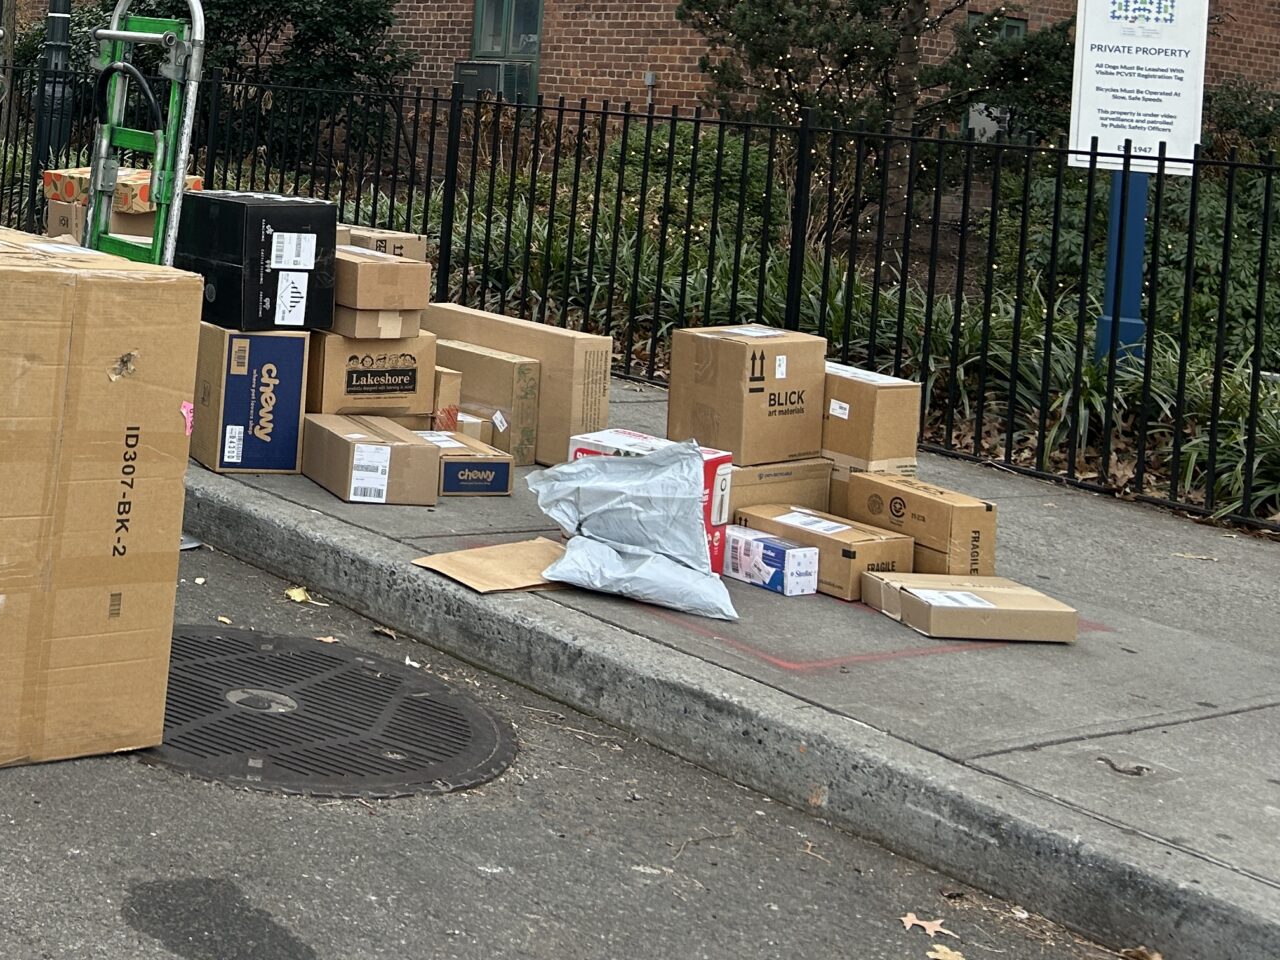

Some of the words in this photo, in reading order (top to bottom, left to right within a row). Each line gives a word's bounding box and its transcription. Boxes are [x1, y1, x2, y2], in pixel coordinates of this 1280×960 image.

[1090, 43, 1133, 54] PRIVATE
[1135, 47, 1190, 58] PROPERTY
[352, 373, 410, 385] Lakeshore
[254, 363, 280, 443] chewy
[768, 390, 805, 407] BLICK
[768, 409, 777, 417] art
[778, 407, 805, 416] materials
[458, 468, 495, 482] chewy
[112, 426, 140, 557] ID307-BK-2
[970, 530, 981, 575] FRAGILE
[867, 561, 896, 572] FRAGILE
